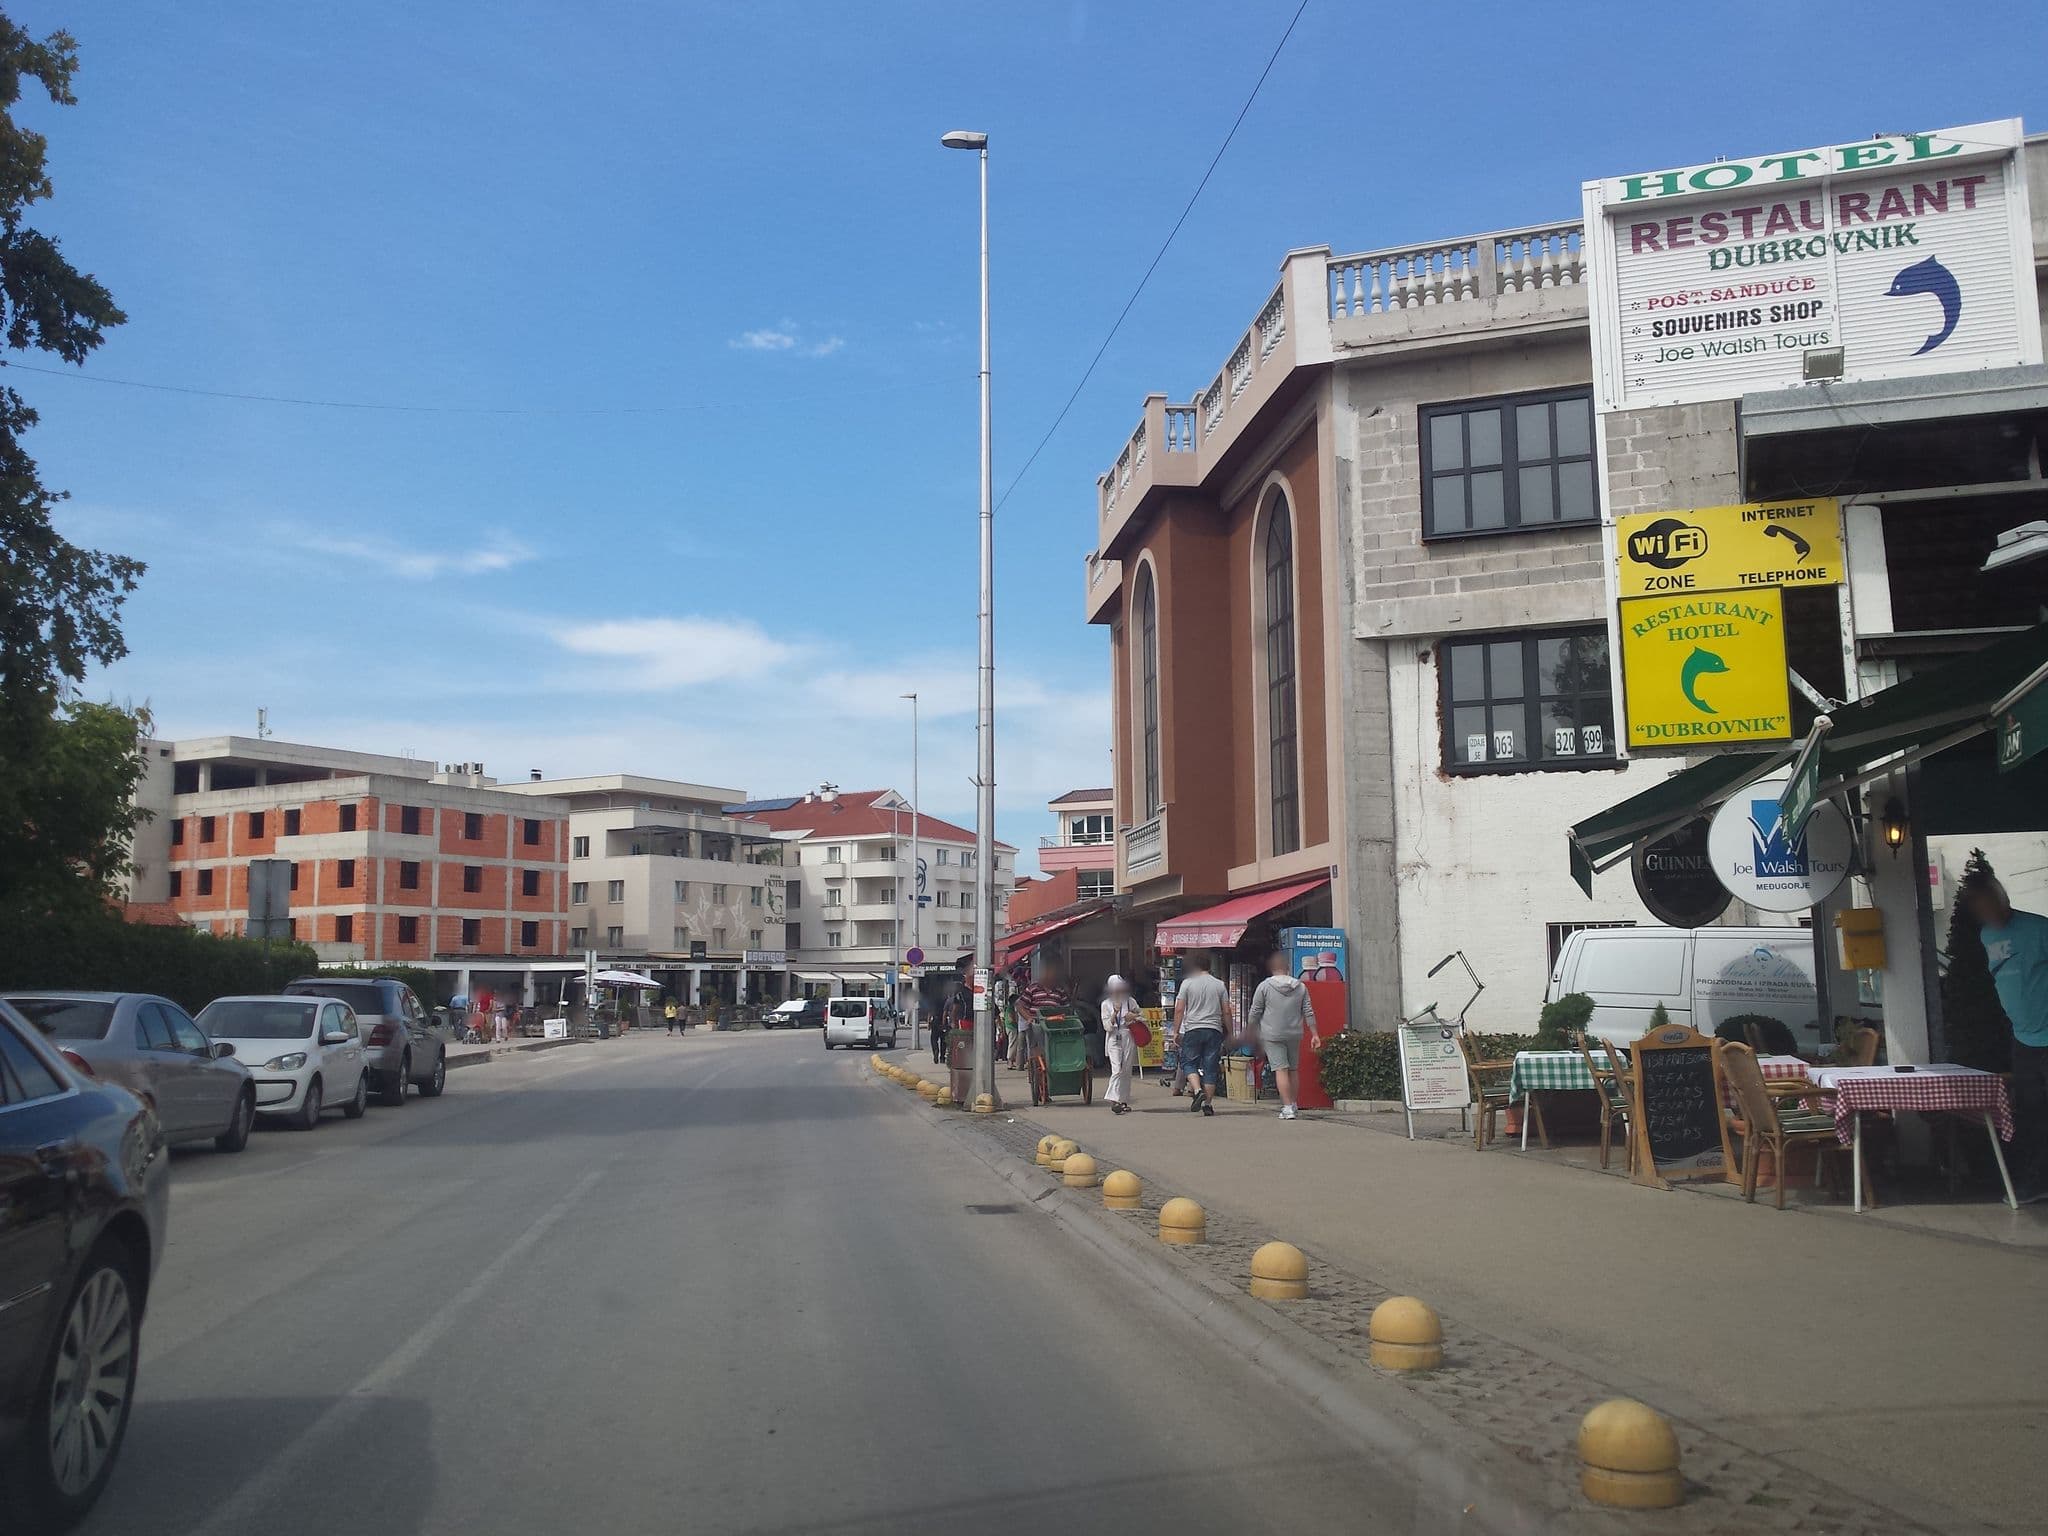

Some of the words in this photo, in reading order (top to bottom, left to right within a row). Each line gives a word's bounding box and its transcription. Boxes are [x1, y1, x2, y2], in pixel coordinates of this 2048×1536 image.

[1620, 135, 1963, 201] HOTEL
[1631, 175, 1986, 254] RESTAURANT
[1709, 223, 1920, 271] DUBROVNIK
[1710, 276, 1816, 303] SANDUČE
[1652, 307, 1762, 338] SOUVENIRS
[1770, 300, 1824, 323] SHOP
[1654, 347, 1695, 364] Joe
[1702, 337, 1767, 358] Walsh
[1773, 329, 1830, 350] Tours
[1741, 505, 1815, 522] INTERNET
[1644, 574, 1696, 591] ZONE
[1738, 567, 1827, 585] TELEPHONE
[1631, 602, 1773, 638] RESTAURANT
[1667, 623, 1740, 642] HOTEL
[1494, 735, 1513, 755] 063
[1556, 731, 1575, 752] 320
[1646, 854, 1711, 871] GUINNE
[1733, 862, 1753, 876] Joe
[1761, 858, 1804, 874] Walsh
[1809, 859, 1846, 873] Tours
[764, 877, 786, 888] HOTEL
